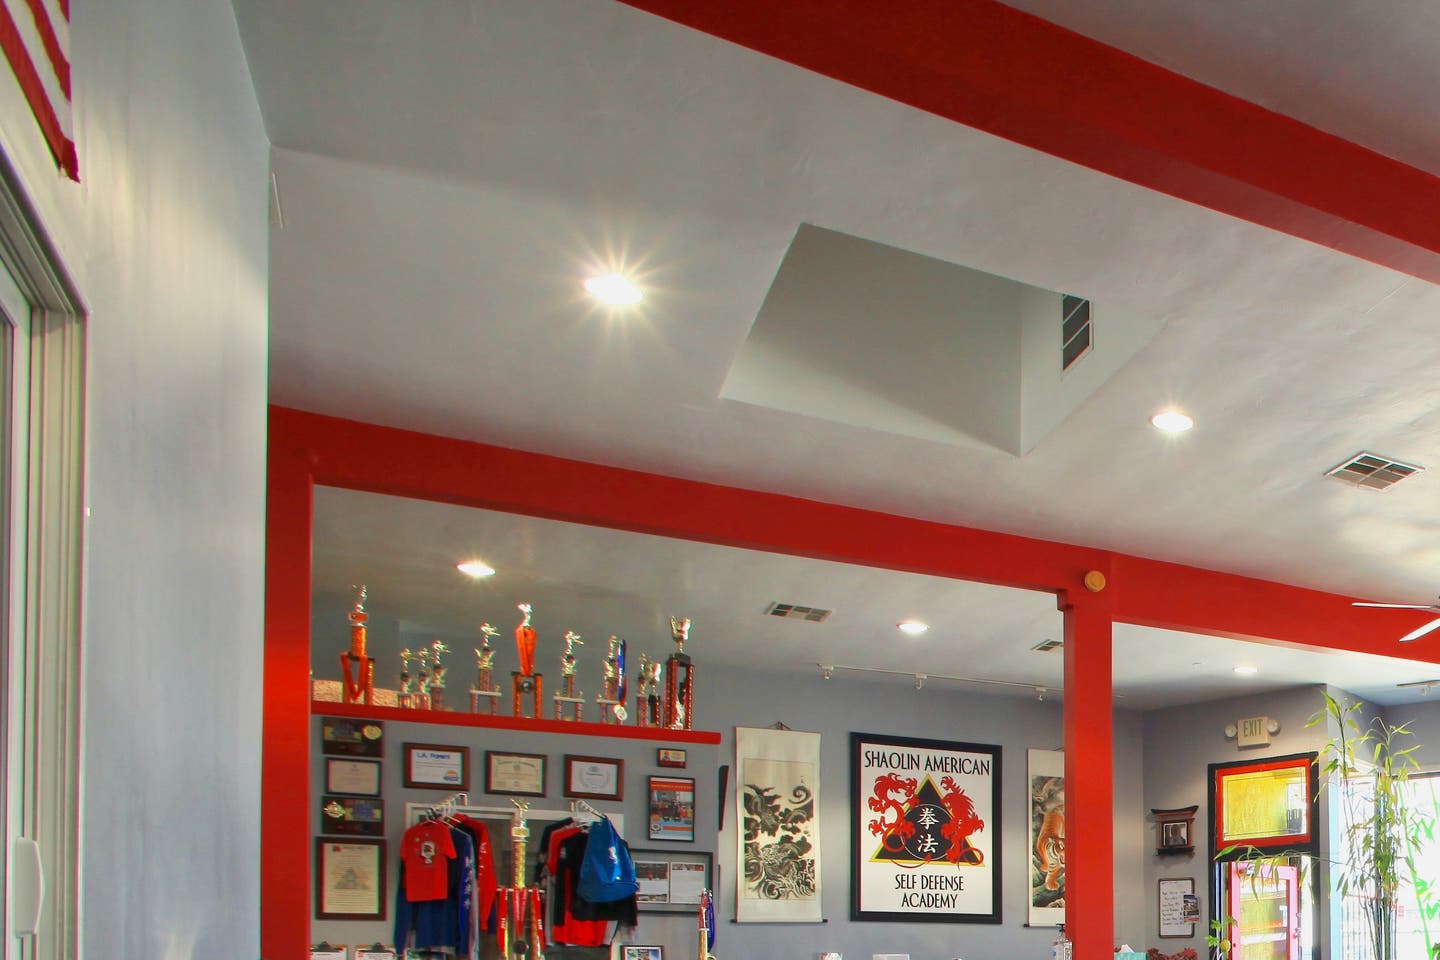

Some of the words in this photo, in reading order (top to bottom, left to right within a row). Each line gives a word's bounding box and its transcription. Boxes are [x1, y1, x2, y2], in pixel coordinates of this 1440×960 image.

[1243, 718, 1263, 737] EXIT
[864, 750, 920, 770] SHAOLIN
[924, 755, 990, 776] AMERICAN
[917, 807, 940, 853] 拳法
[895, 873, 917, 890] SELF
[921, 874, 964, 891] DEFENSE
[901, 892, 958, 909] ACADEMY
